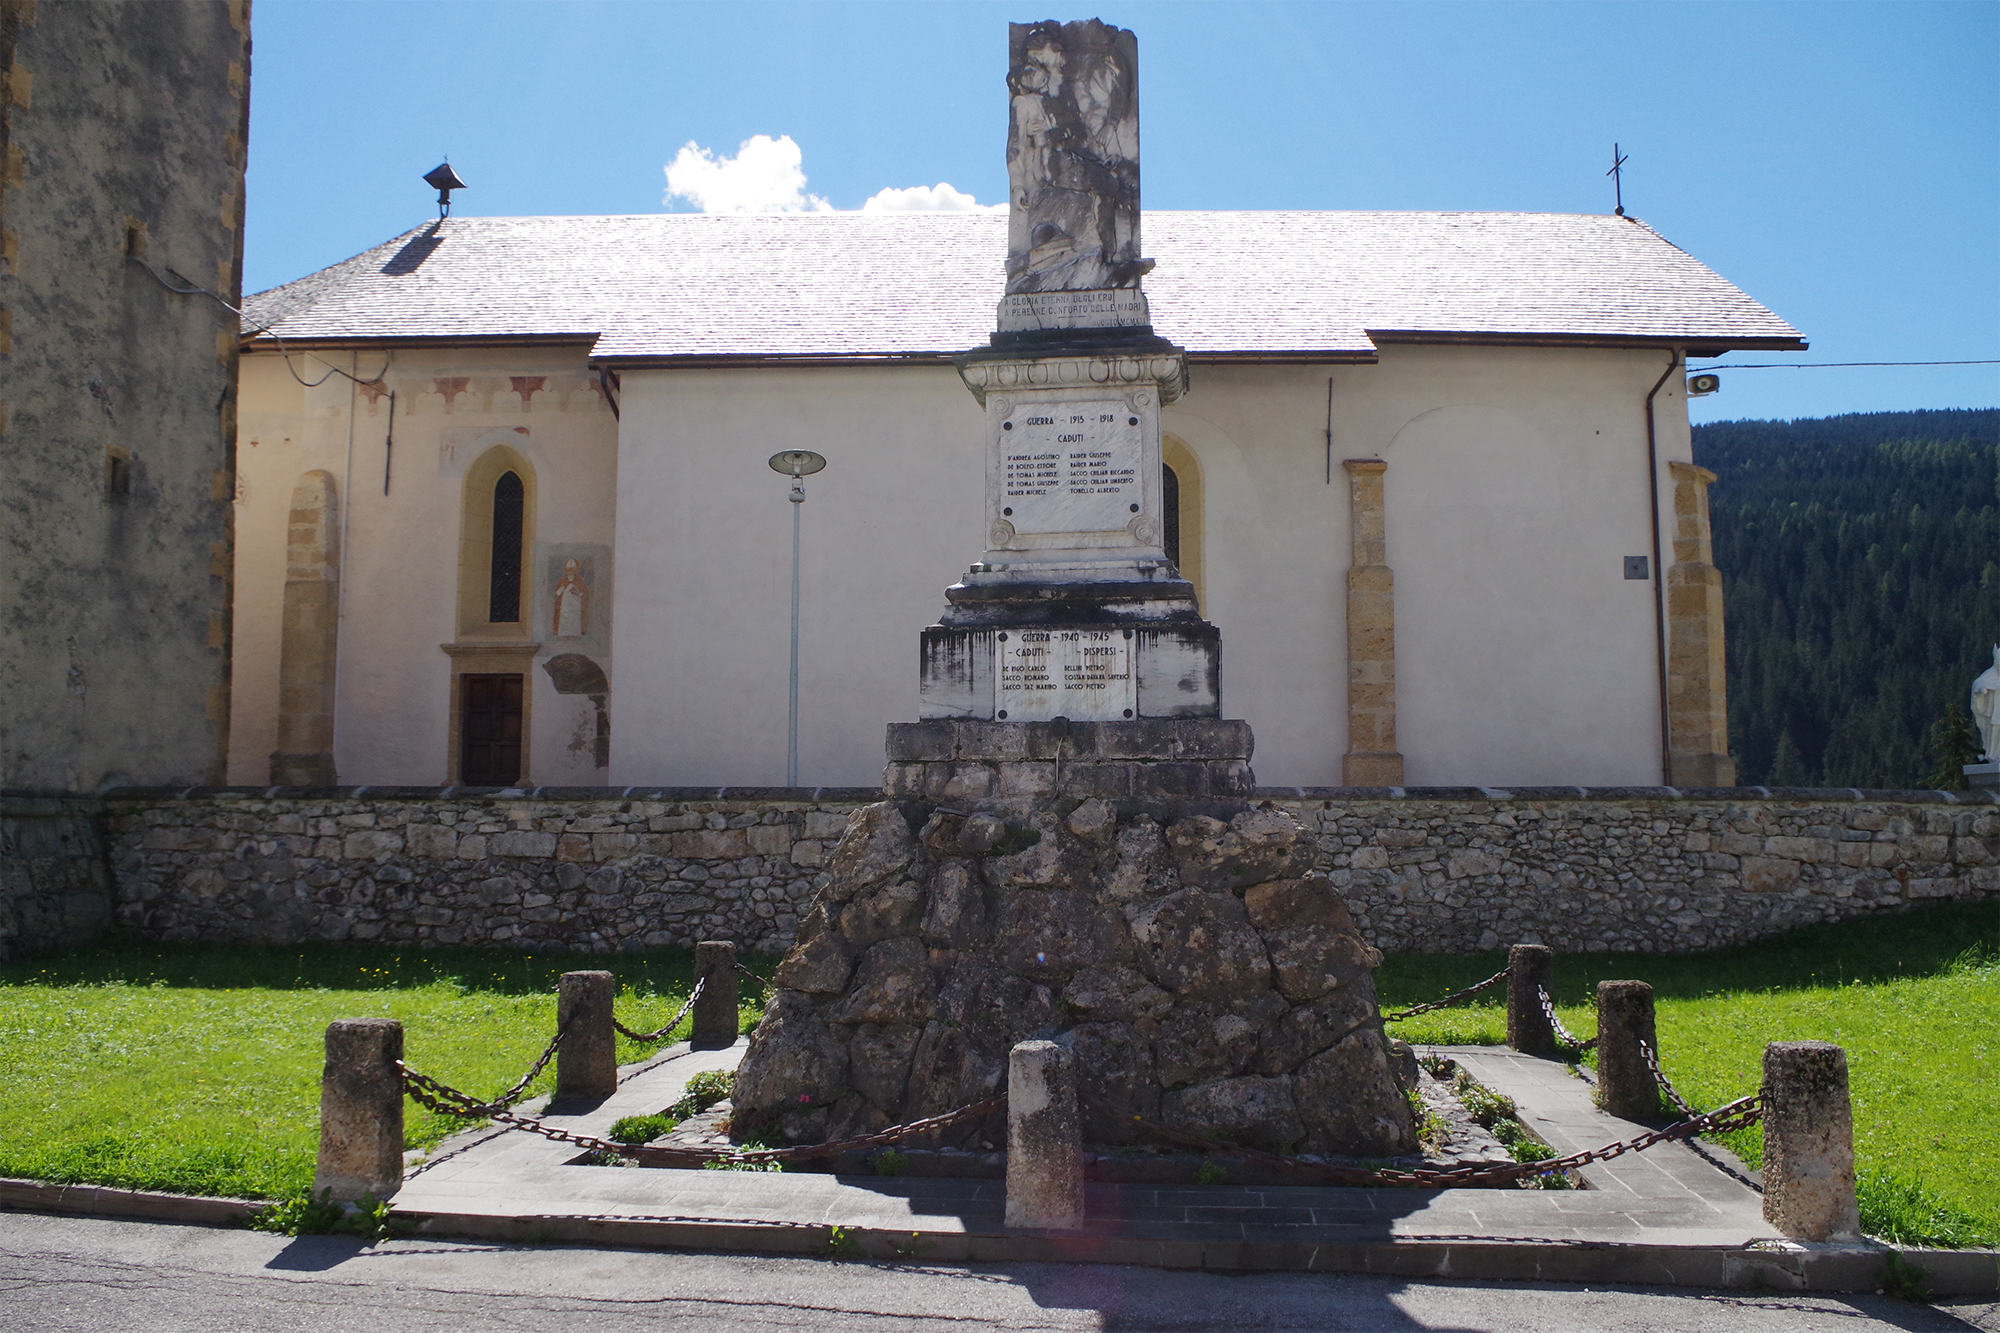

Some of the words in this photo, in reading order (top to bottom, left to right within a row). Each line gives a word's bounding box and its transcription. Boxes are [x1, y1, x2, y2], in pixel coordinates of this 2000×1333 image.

[1012, 297, 1038, 306] GLORIA
[1041, 295, 1070, 304] ETERNA
[1073, 294, 1096, 302] DEGLI
[1012, 307, 1046, 316] PERENNE
[1048, 305, 1088, 315] CONFORTO
[1091, 304, 1115, 313] DELLE
[1118, 302, 1141, 311] MADRI
[1026, 418, 1054, 426] GUERRA
[1069, 416, 1085, 424] 1915
[1099, 414, 1114, 423] 1918
[1057, 434, 1084, 443] CADUTI
[1021, 633, 1050, 642] GUERRA
[1061, 633, 1080, 642] 1940
[1090, 633, 1109, 641] 1945
[1016, 648, 1044, 657] CADUTI
[1084, 647, 1117, 656] DISPERSI
